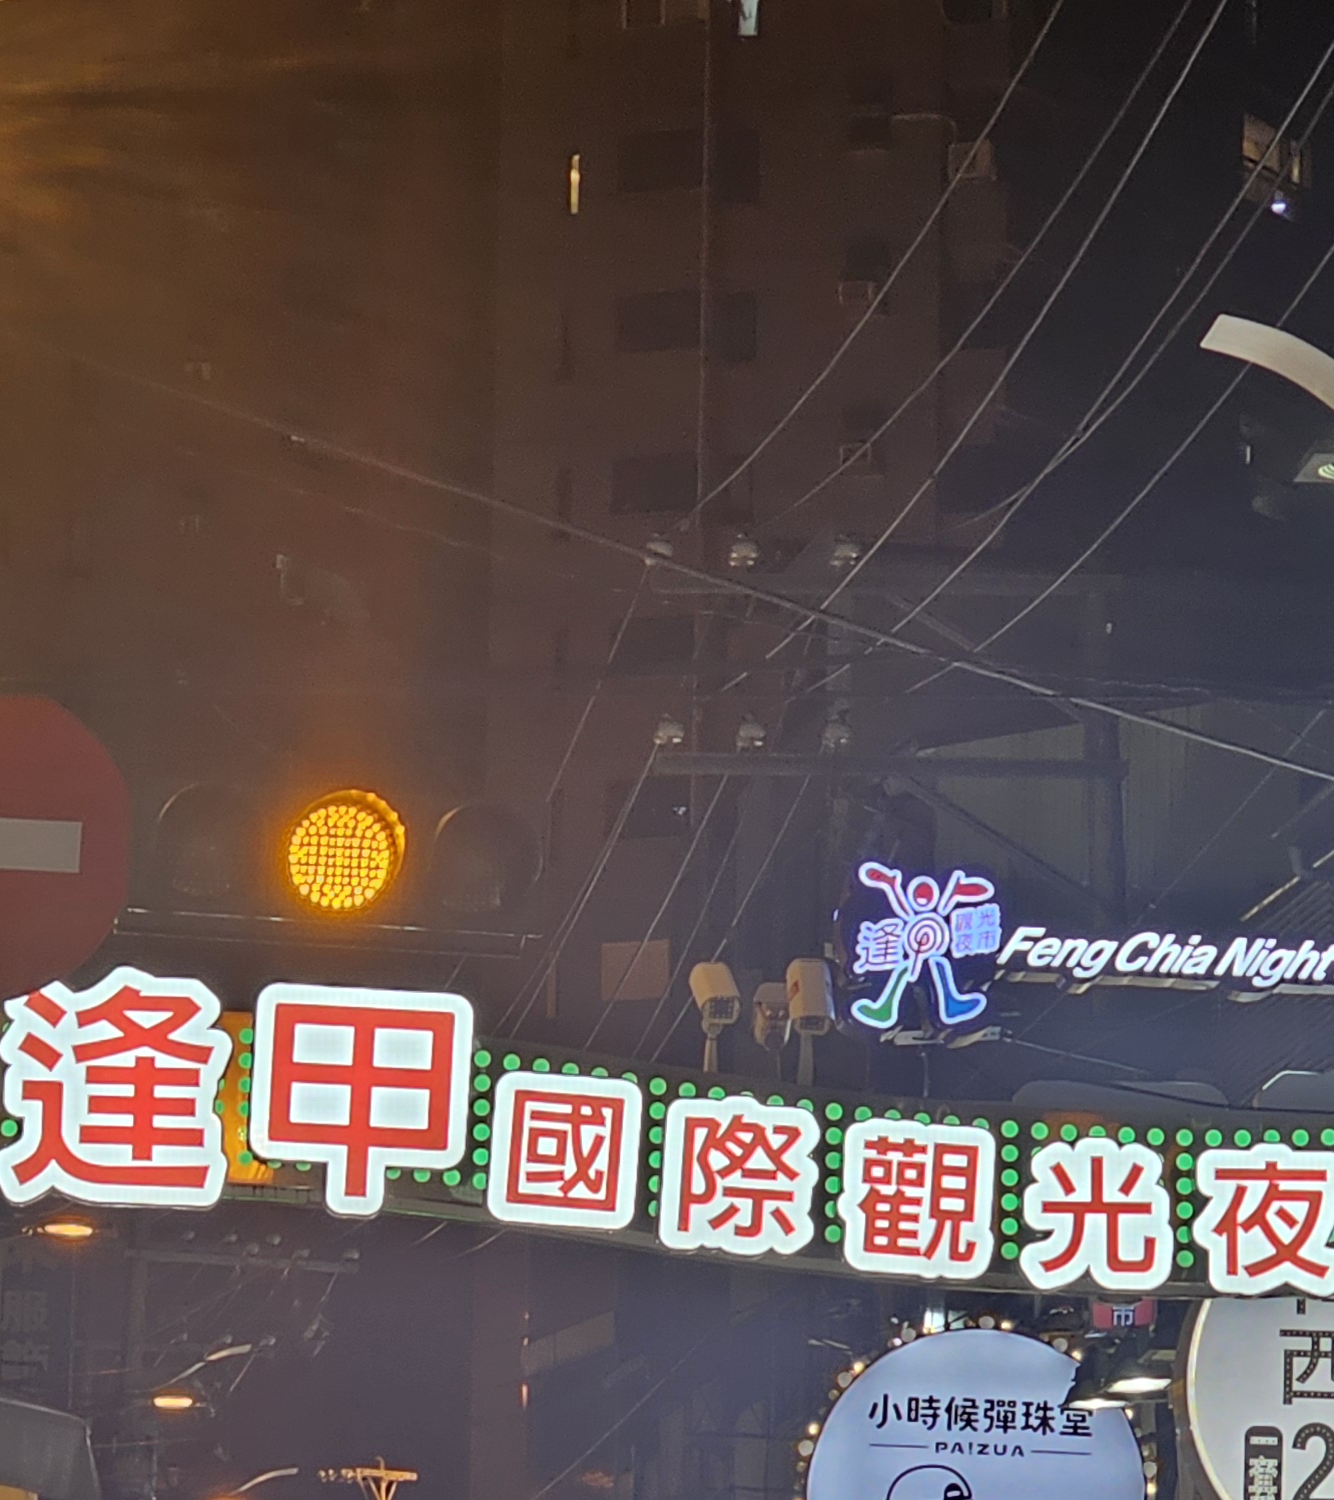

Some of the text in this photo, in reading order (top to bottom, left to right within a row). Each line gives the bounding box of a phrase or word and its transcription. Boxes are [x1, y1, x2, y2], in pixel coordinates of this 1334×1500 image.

[997, 926, 1118, 978] Feng
[1114, 931, 1219, 976] Chia
[868, 1393, 1094, 1437] 小時候彈珠堂
